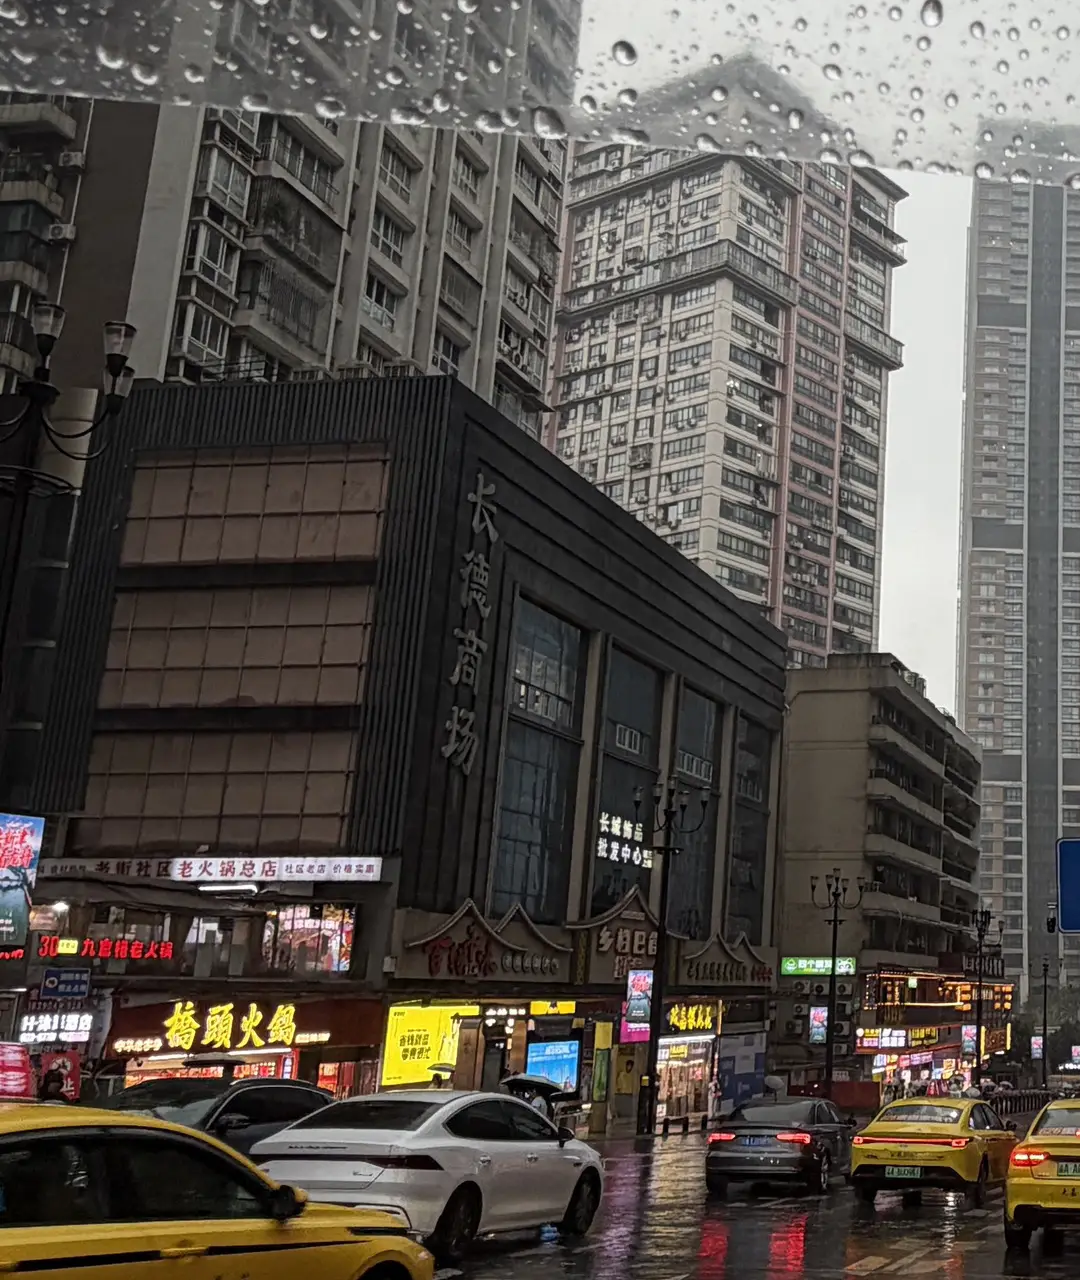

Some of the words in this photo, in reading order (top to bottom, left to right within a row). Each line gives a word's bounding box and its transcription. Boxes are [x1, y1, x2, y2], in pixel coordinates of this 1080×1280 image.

[597, 837, 642, 865] 批发中心
[164, 1001, 297, 1050] 橋頭火鍋
